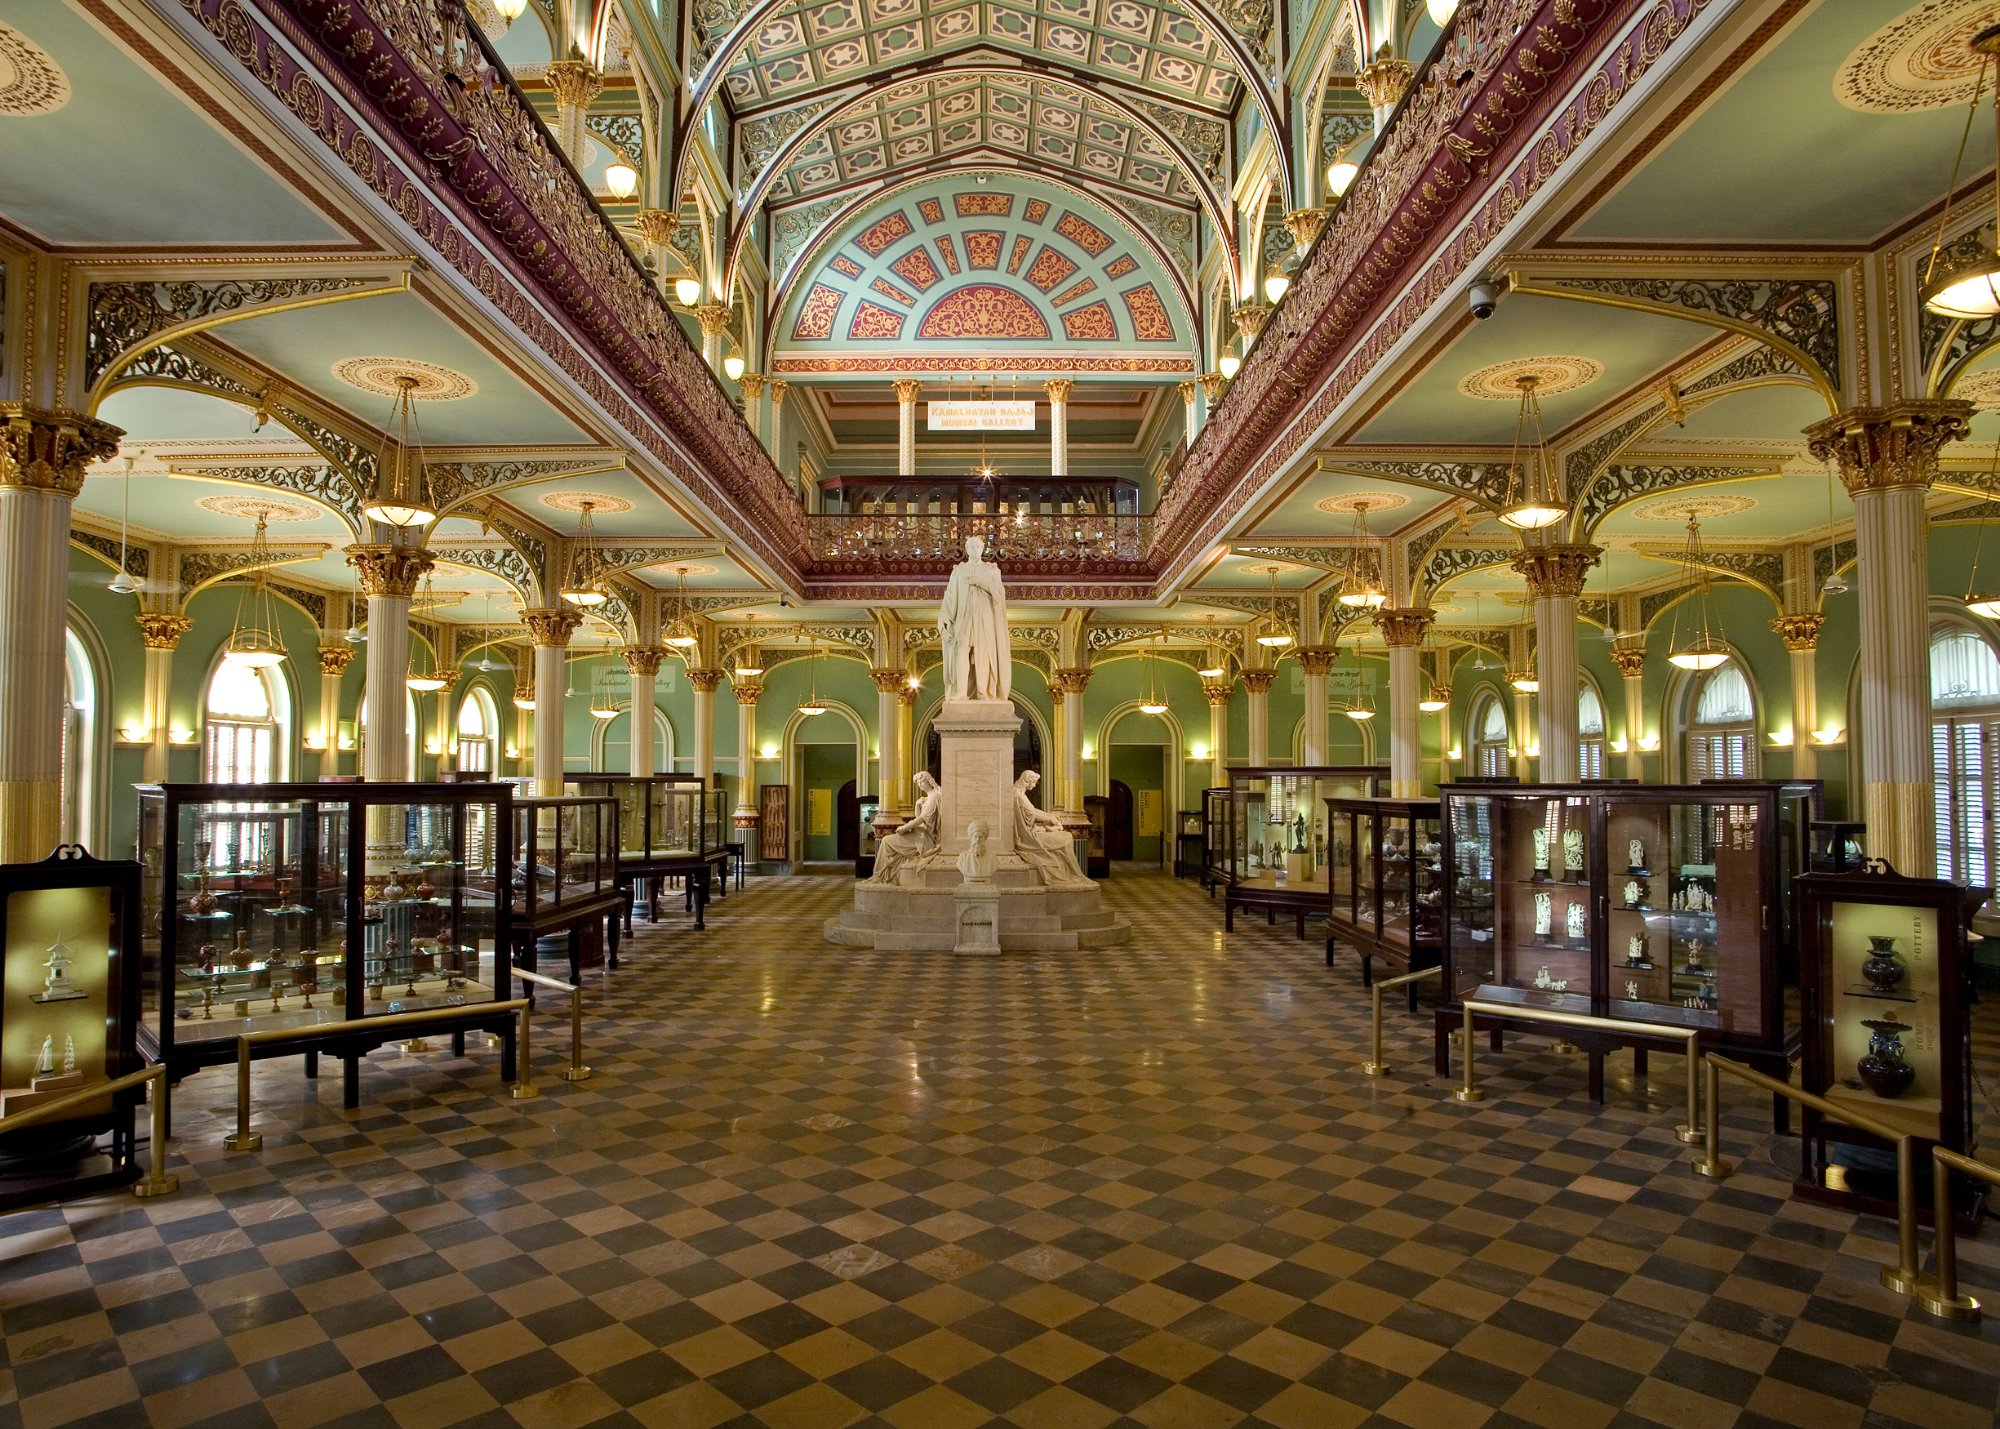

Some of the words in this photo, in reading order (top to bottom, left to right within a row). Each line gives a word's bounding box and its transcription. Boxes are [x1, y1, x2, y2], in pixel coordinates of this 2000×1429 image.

[1000, 407, 1034, 417] BAJAJ
[941, 418, 977, 427] MUMBAI
[981, 418, 1025, 427] GALLERY
[1914, 915, 1922, 960] POTTERY
